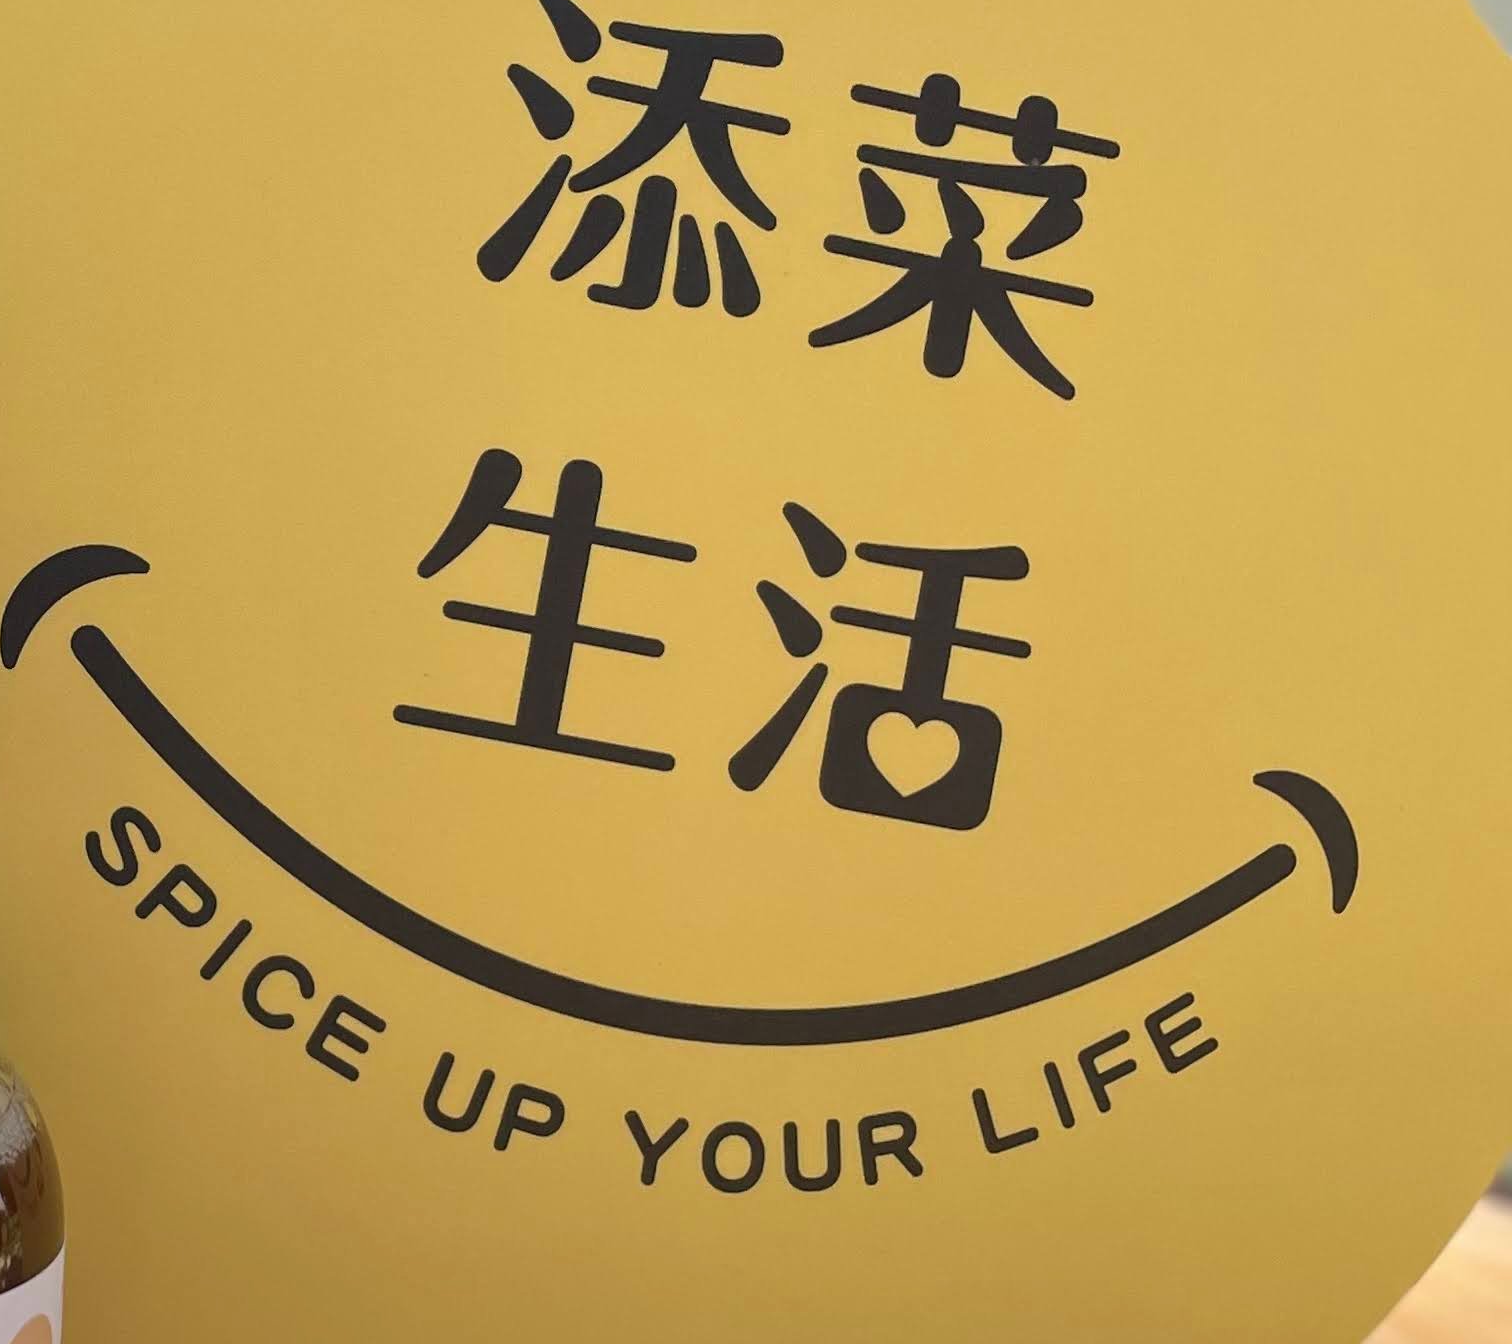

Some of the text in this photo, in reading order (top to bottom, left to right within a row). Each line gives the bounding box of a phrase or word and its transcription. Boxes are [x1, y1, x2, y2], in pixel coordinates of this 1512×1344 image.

[393, 449, 1032, 831] 生活
[85, 806, 1219, 1194] SPICE UP YOUR LIFE
